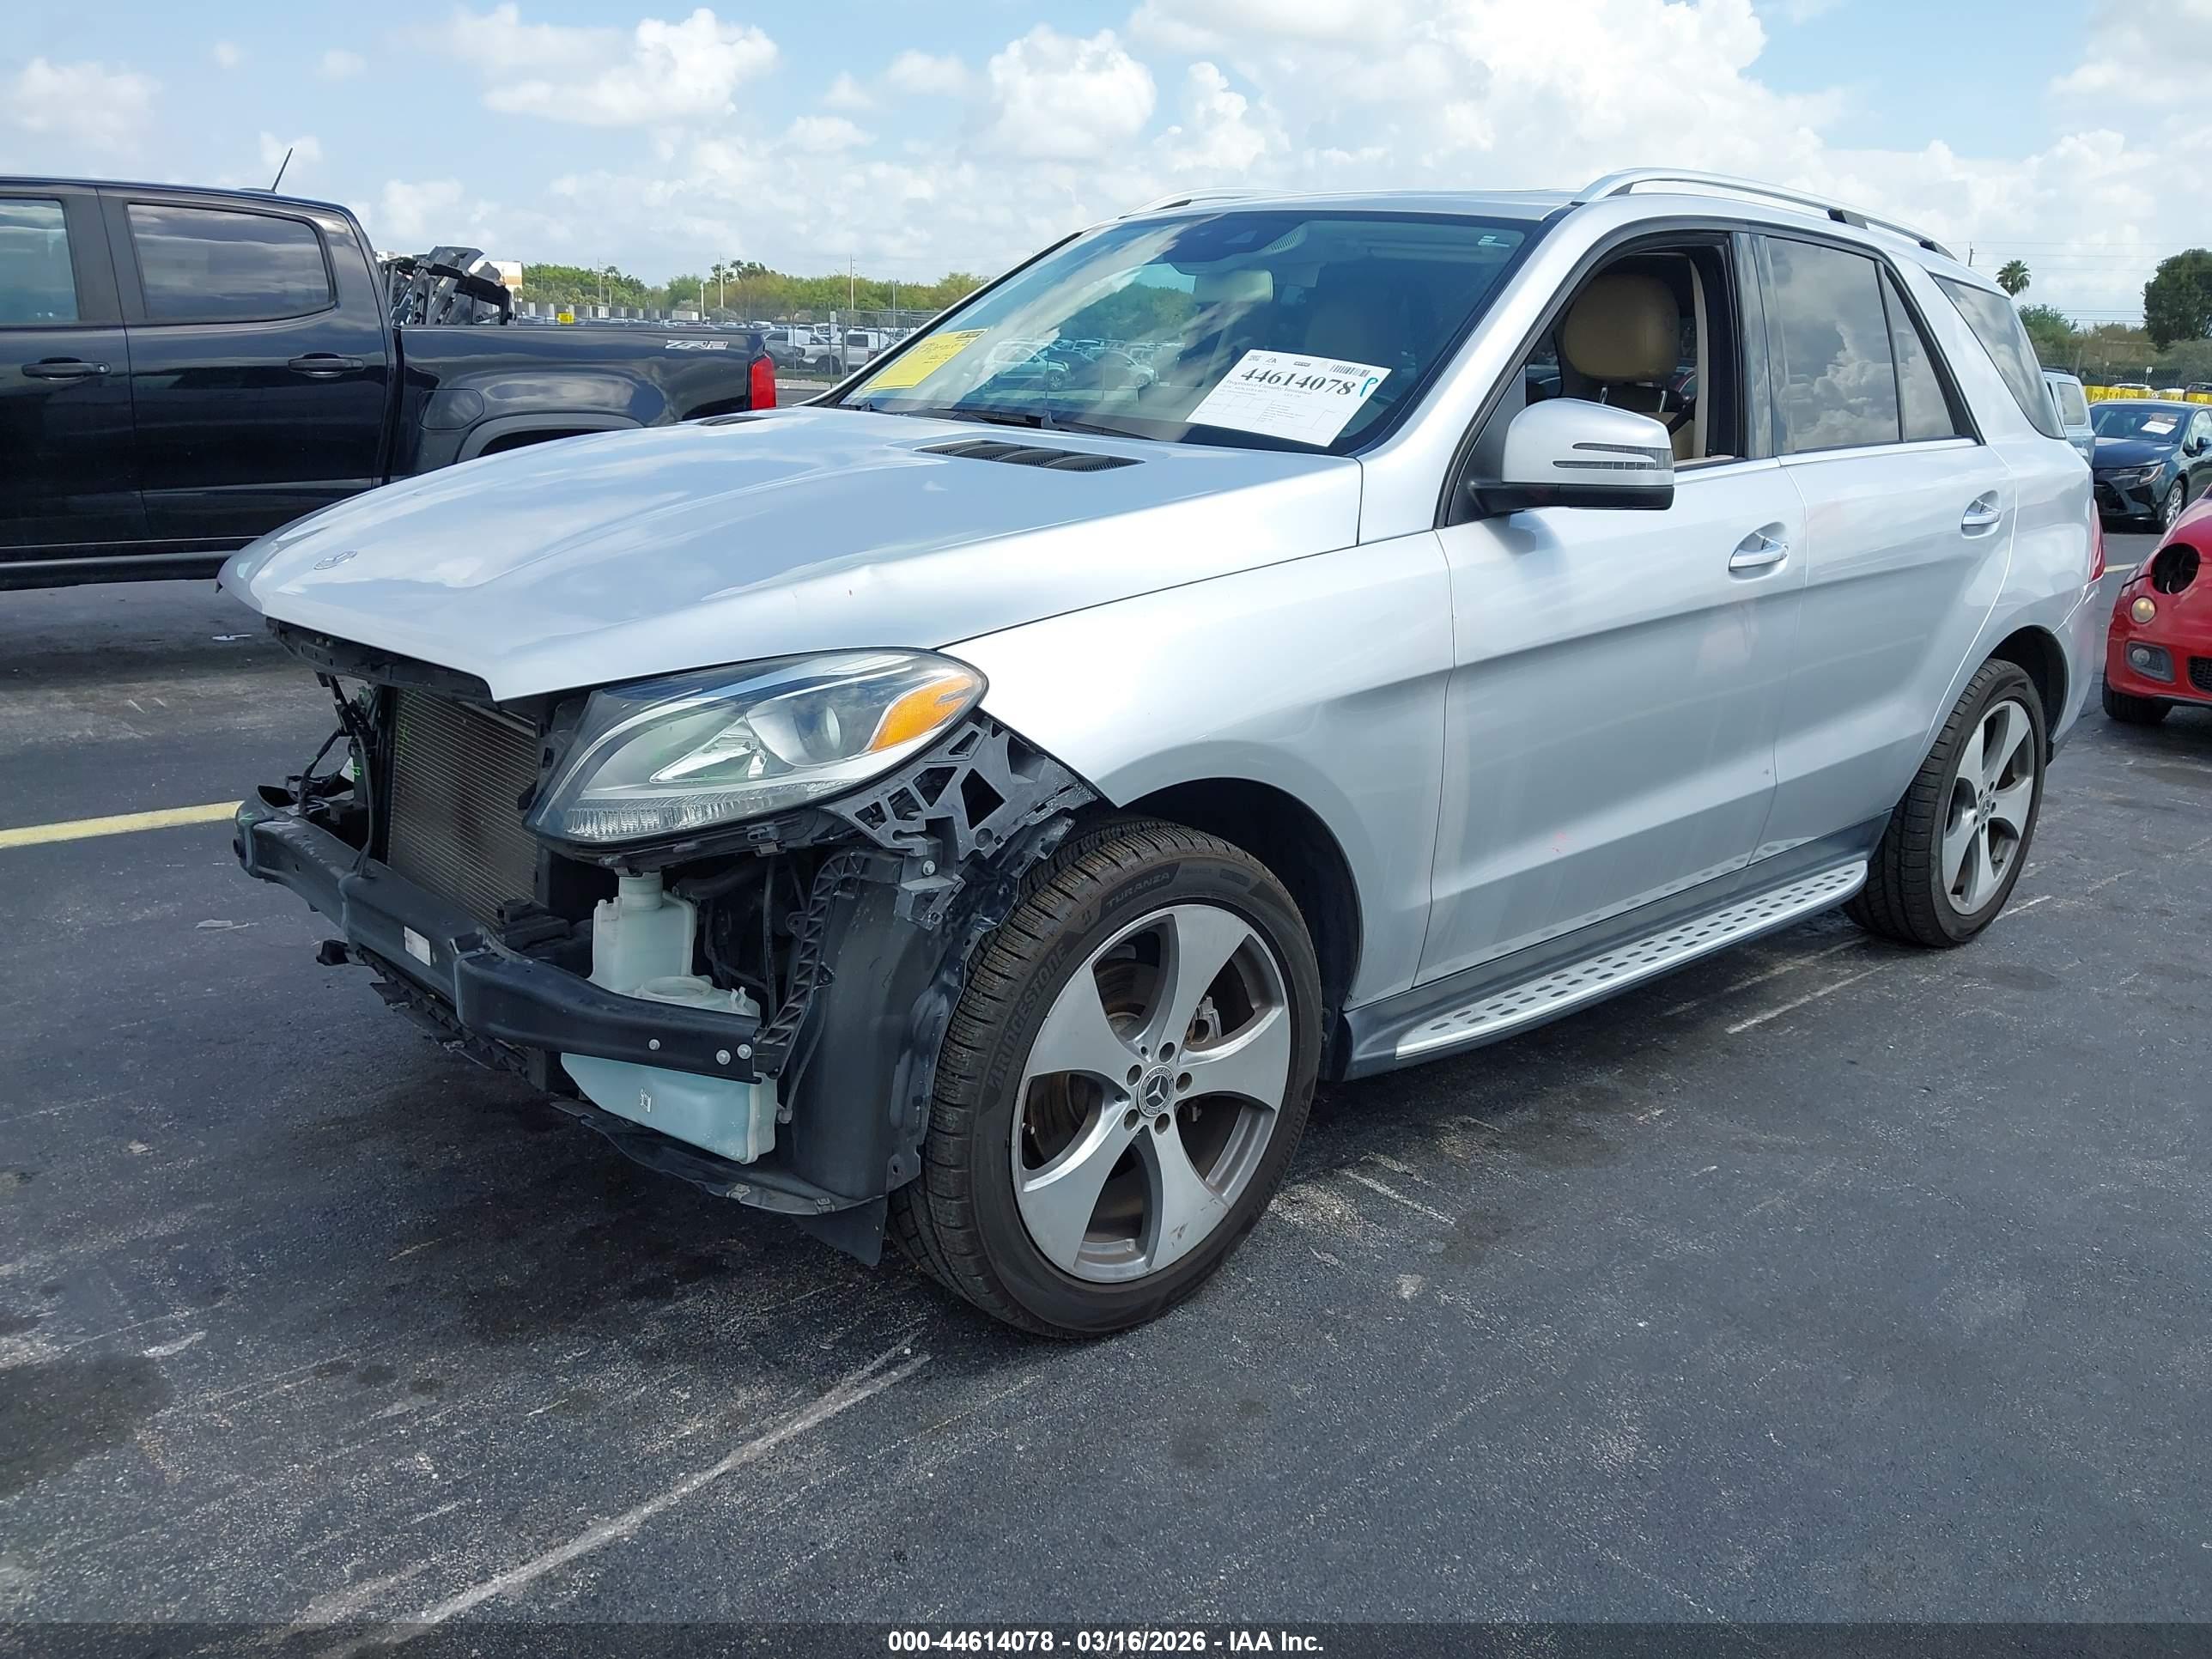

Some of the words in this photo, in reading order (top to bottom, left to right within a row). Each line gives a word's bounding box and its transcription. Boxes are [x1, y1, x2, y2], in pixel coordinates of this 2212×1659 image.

[665, 339, 729, 350] ZR2
[1241, 368, 1356, 396] 44614078
[1107, 872, 1171, 908] TURANZA
[988, 945, 1070, 1091] BRIDGESTONE
